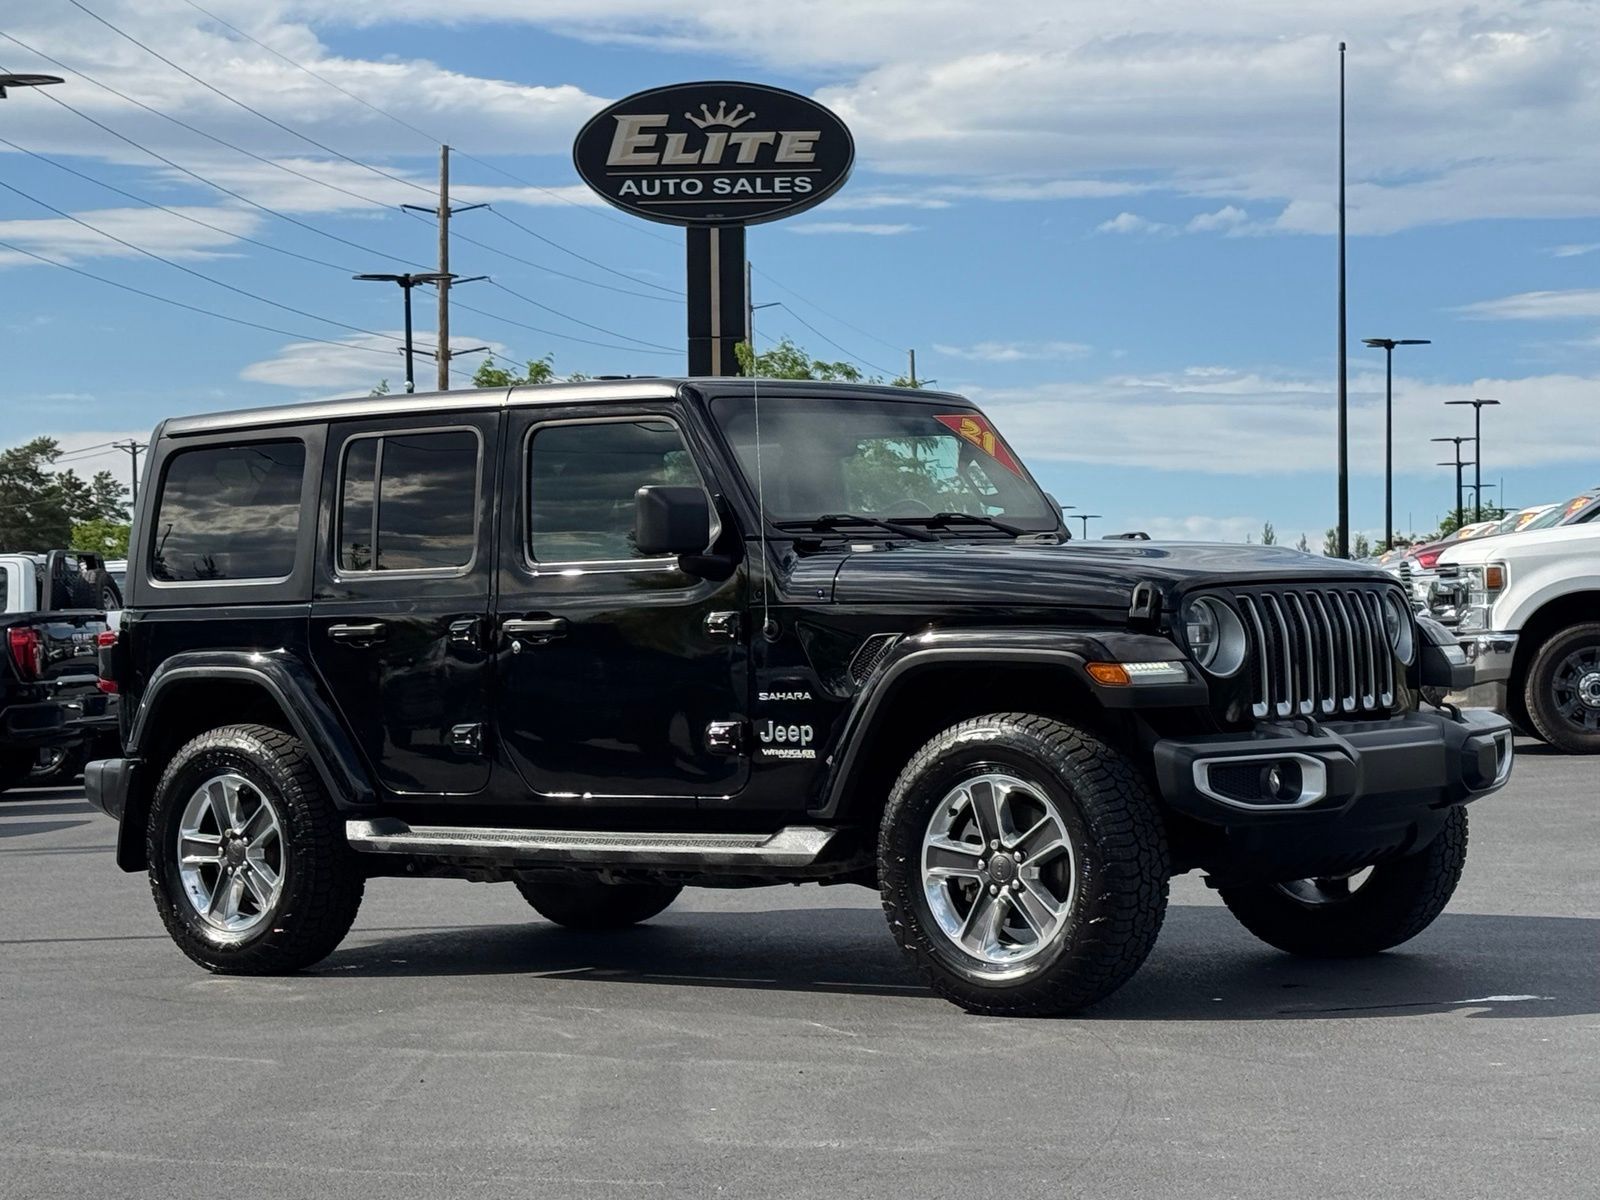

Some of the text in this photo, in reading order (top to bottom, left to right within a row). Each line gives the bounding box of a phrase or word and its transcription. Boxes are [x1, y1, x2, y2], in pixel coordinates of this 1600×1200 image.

[605, 113, 822, 166] ELITE
[618, 176, 813, 196] AUTO SALES
[959, 417, 996, 457] 21
[758, 692, 812, 700] SAHARA
[760, 720, 814, 746] Jeep
[761, 748, 816, 757] WRANGLER
